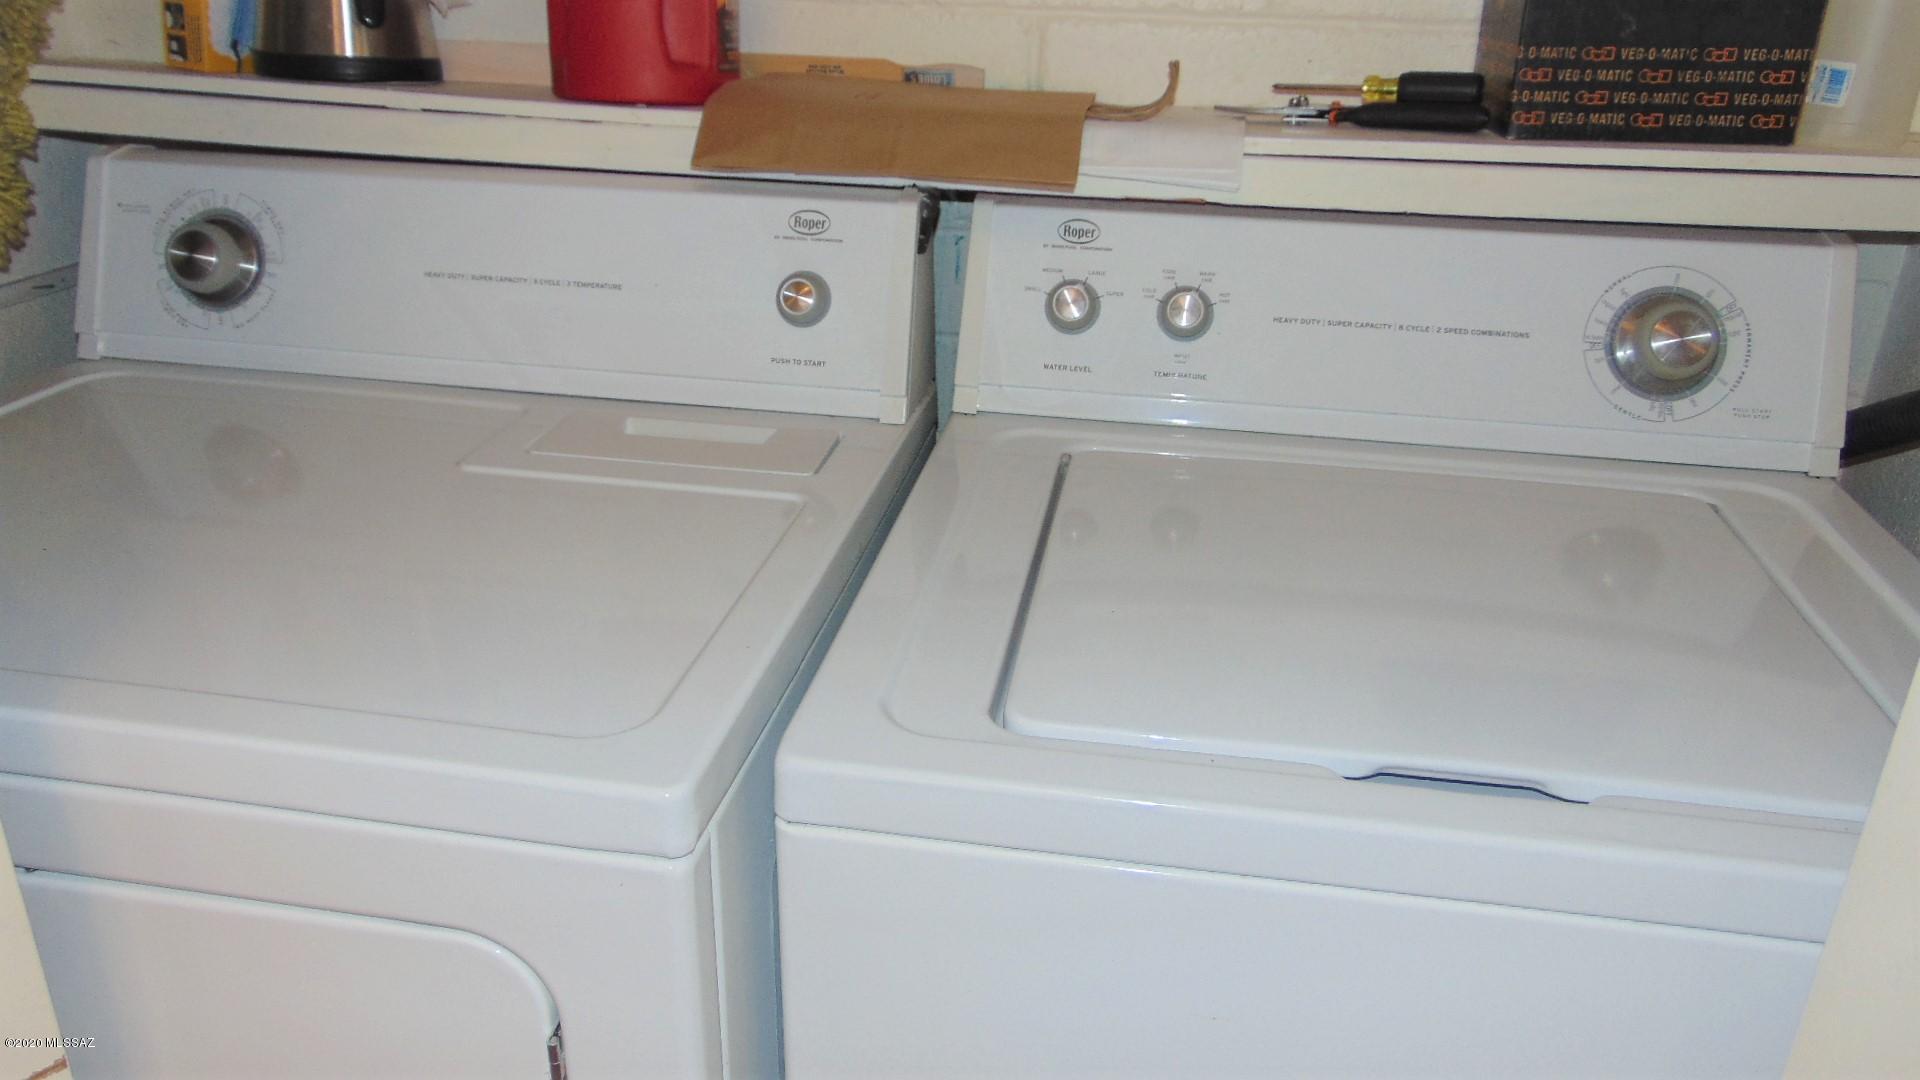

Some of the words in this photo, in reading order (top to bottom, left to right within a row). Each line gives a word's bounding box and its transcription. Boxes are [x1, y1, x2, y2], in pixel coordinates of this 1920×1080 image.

[1621, 46, 1698, 62] VEG-O-MATIC
[1557, 68, 1634, 82] VEG-O-MATIC
[1677, 70, 1755, 84] VEG-O-MATIC
[1614, 91, 1690, 106] VEG-O-MATIC
[1550, 111, 1626, 126] VEG-O-MATIC
[1668, 114, 1745, 128] VEG-O-MATIC
[793, 215, 827, 232] Roper
[1062, 223, 1097, 240] Roper
[572, 280, 623, 291] TEMPERATURE
[1272, 316, 1300, 325] HEAVY
[1300, 318, 1321, 326] DUTY
[1327, 319, 1353, 328] SUPER
[1354, 321, 1393, 331] CAPACITY
[1405, 324, 1431, 334] CYCLE
[1443, 326, 1469, 336] SPEED
[1470, 328, 1531, 340] COMBINATIONS
[769, 357, 791, 365] PUSH
[792, 358, 802, 366] TO
[803, 359, 827, 367] START
[1043, 361, 1068, 371] WATER
[1069, 364, 1093, 374] LEVEL
